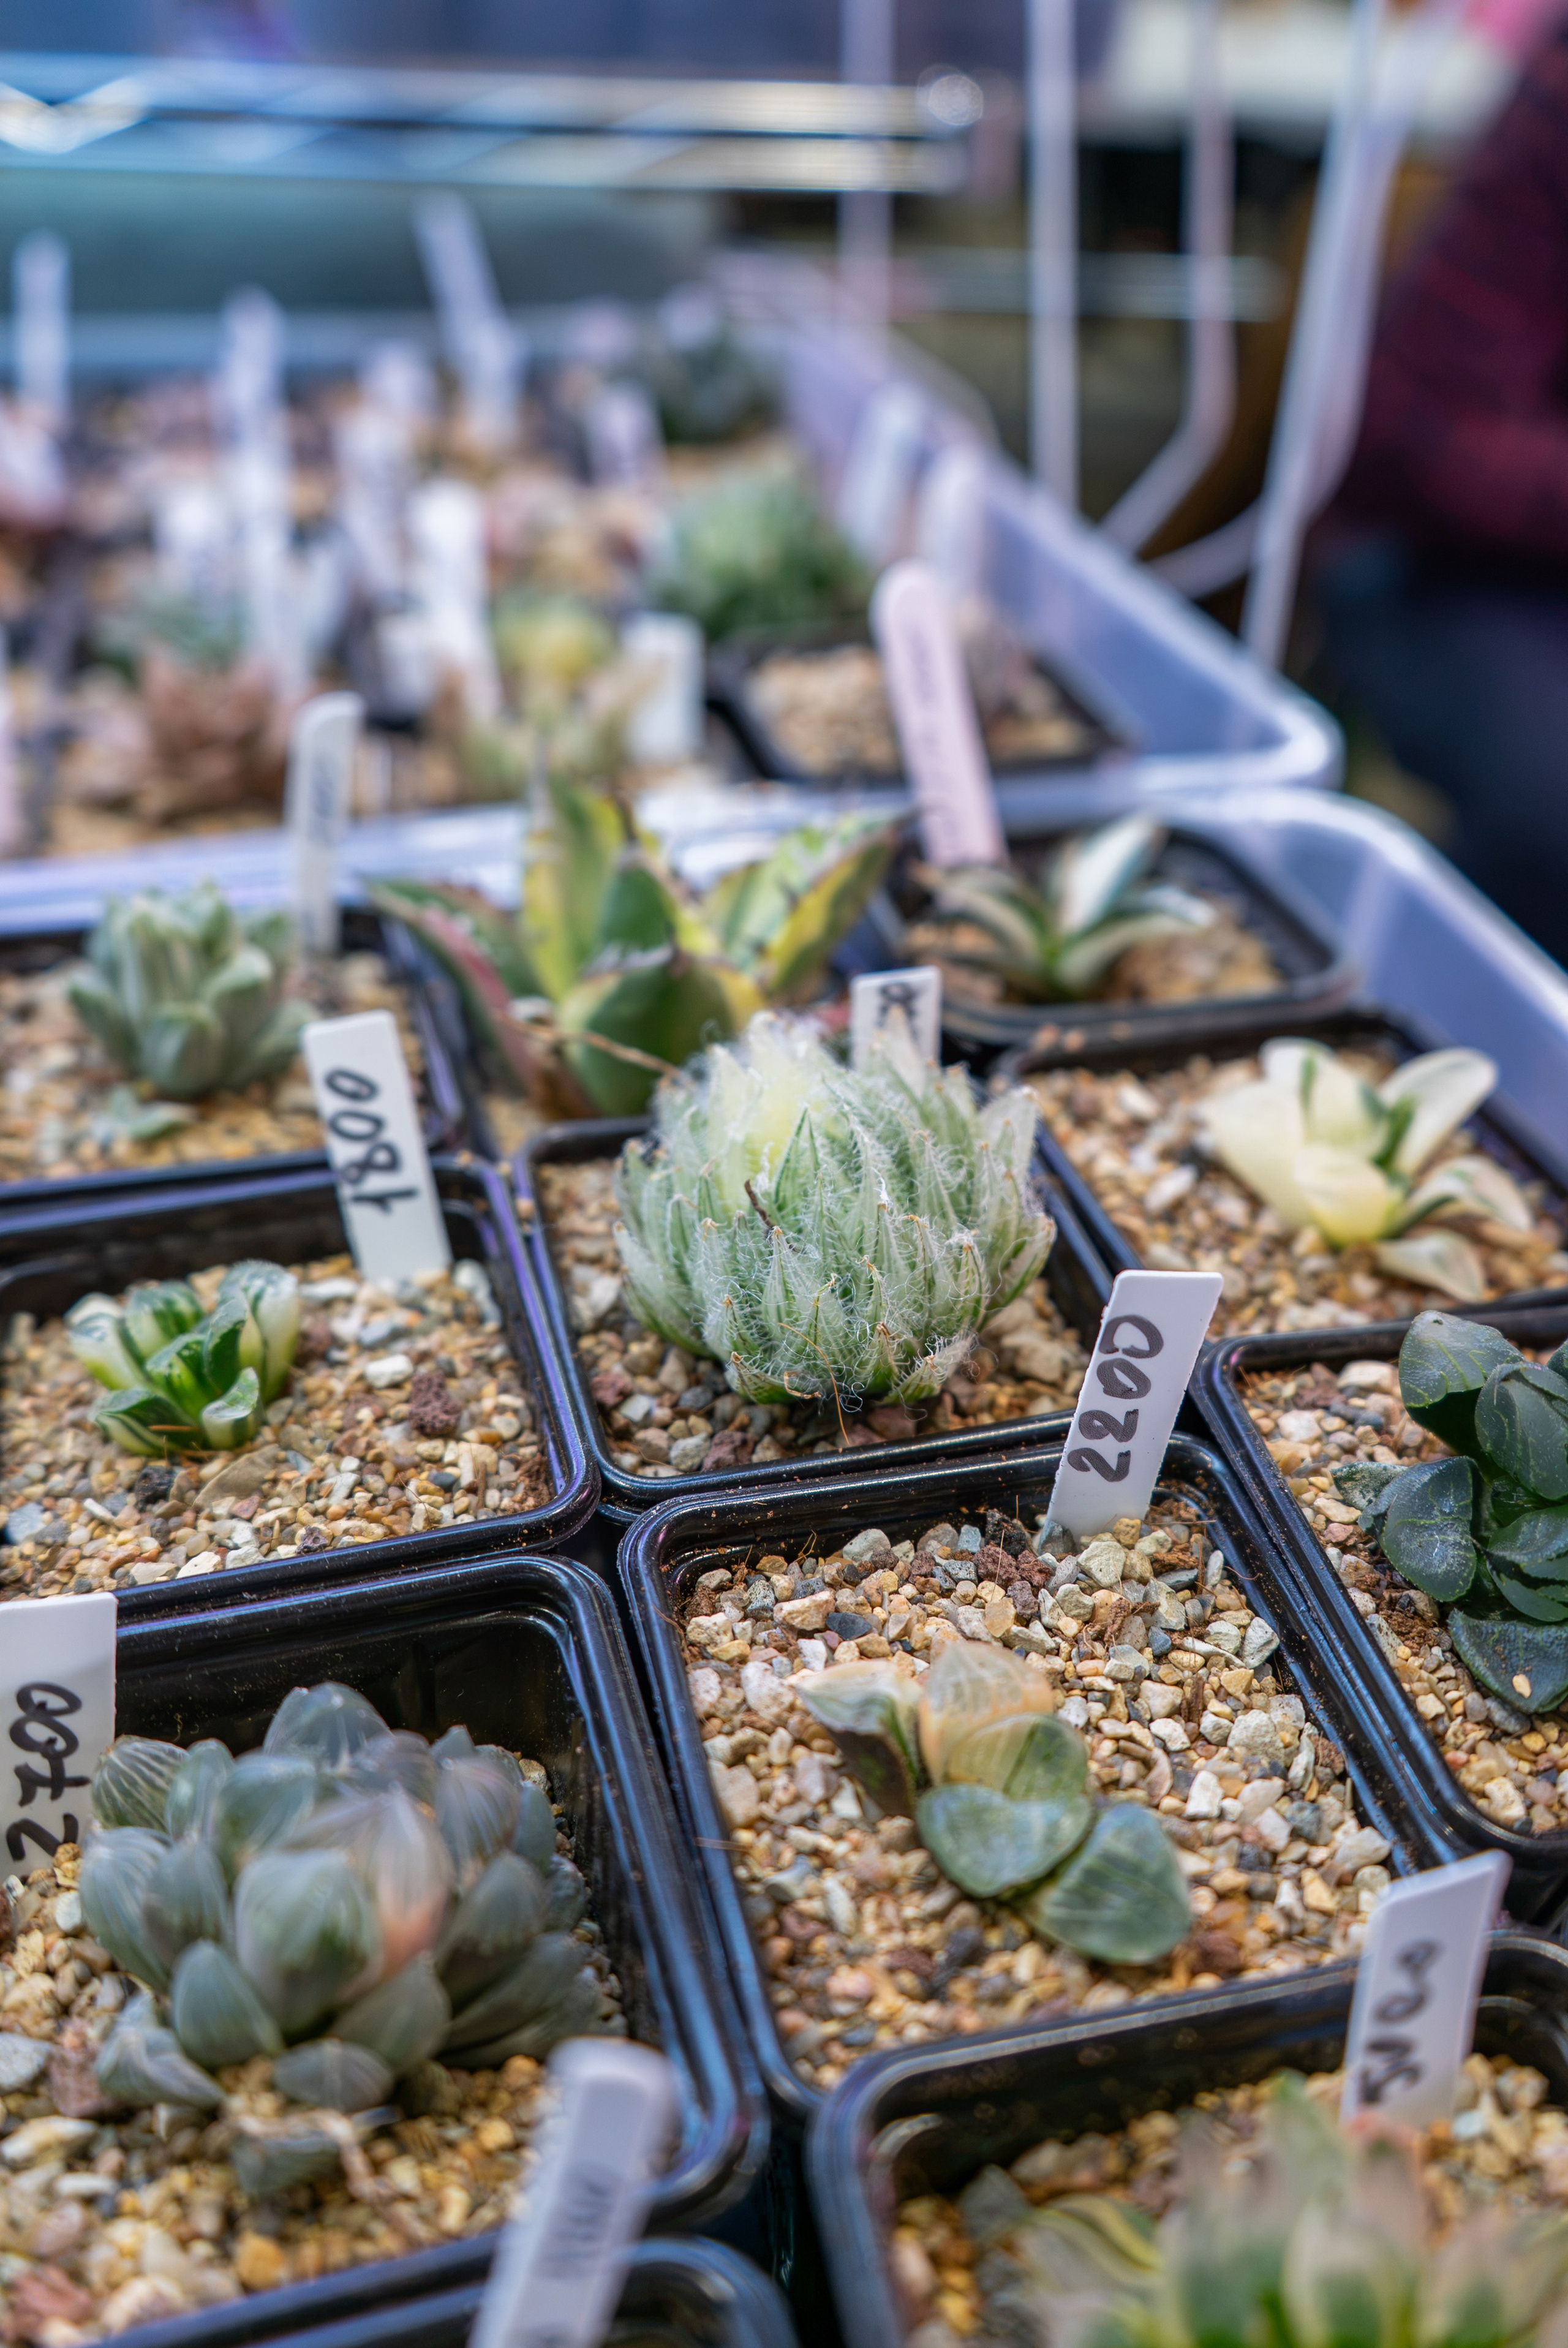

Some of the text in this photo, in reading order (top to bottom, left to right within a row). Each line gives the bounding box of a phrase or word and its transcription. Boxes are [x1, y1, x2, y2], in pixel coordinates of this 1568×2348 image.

[325, 1068, 419, 1214] 1800
[1067, 1314, 1164, 1482] 2200
[6, 1682, 91, 1862] 2700
